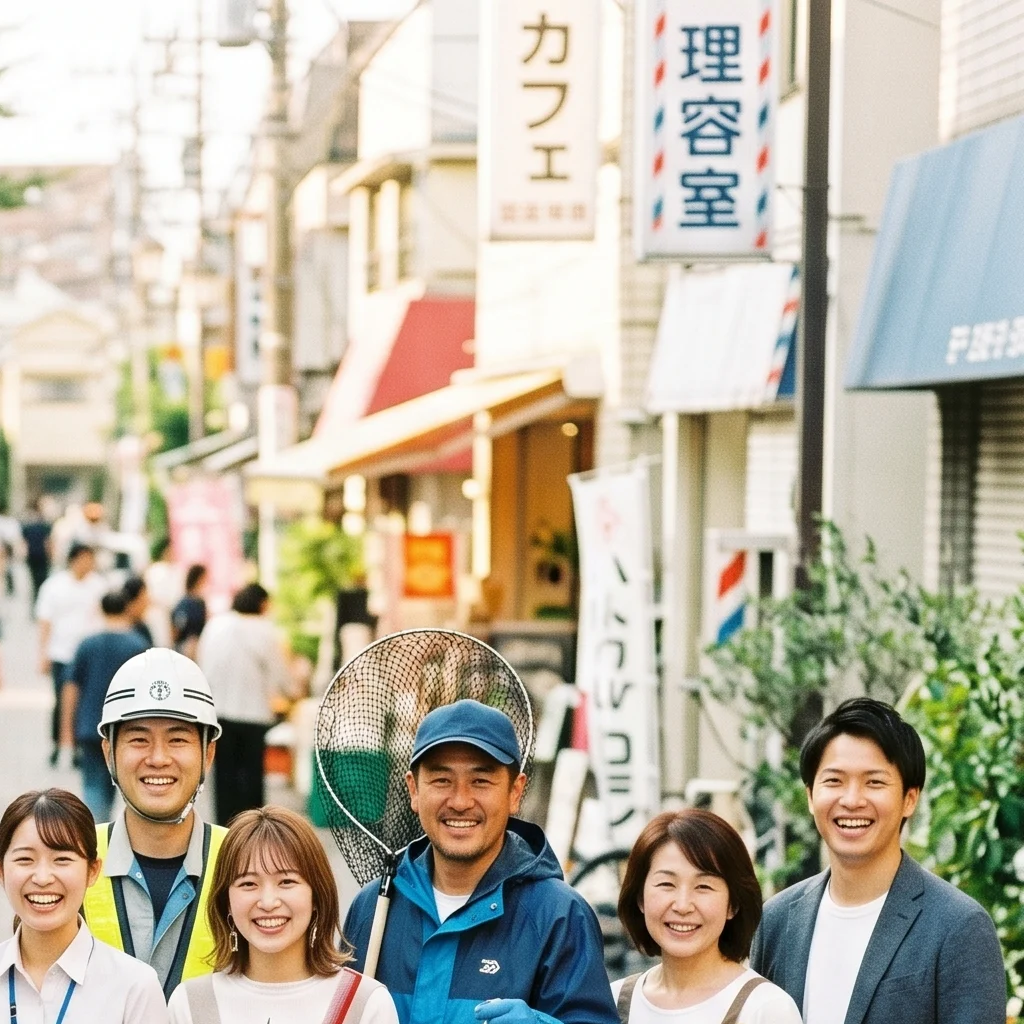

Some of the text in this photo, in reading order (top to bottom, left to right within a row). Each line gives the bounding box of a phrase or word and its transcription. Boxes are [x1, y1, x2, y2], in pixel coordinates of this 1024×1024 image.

[521, 13, 571, 182] カフェ
[679, 23, 743, 229] 理容室
